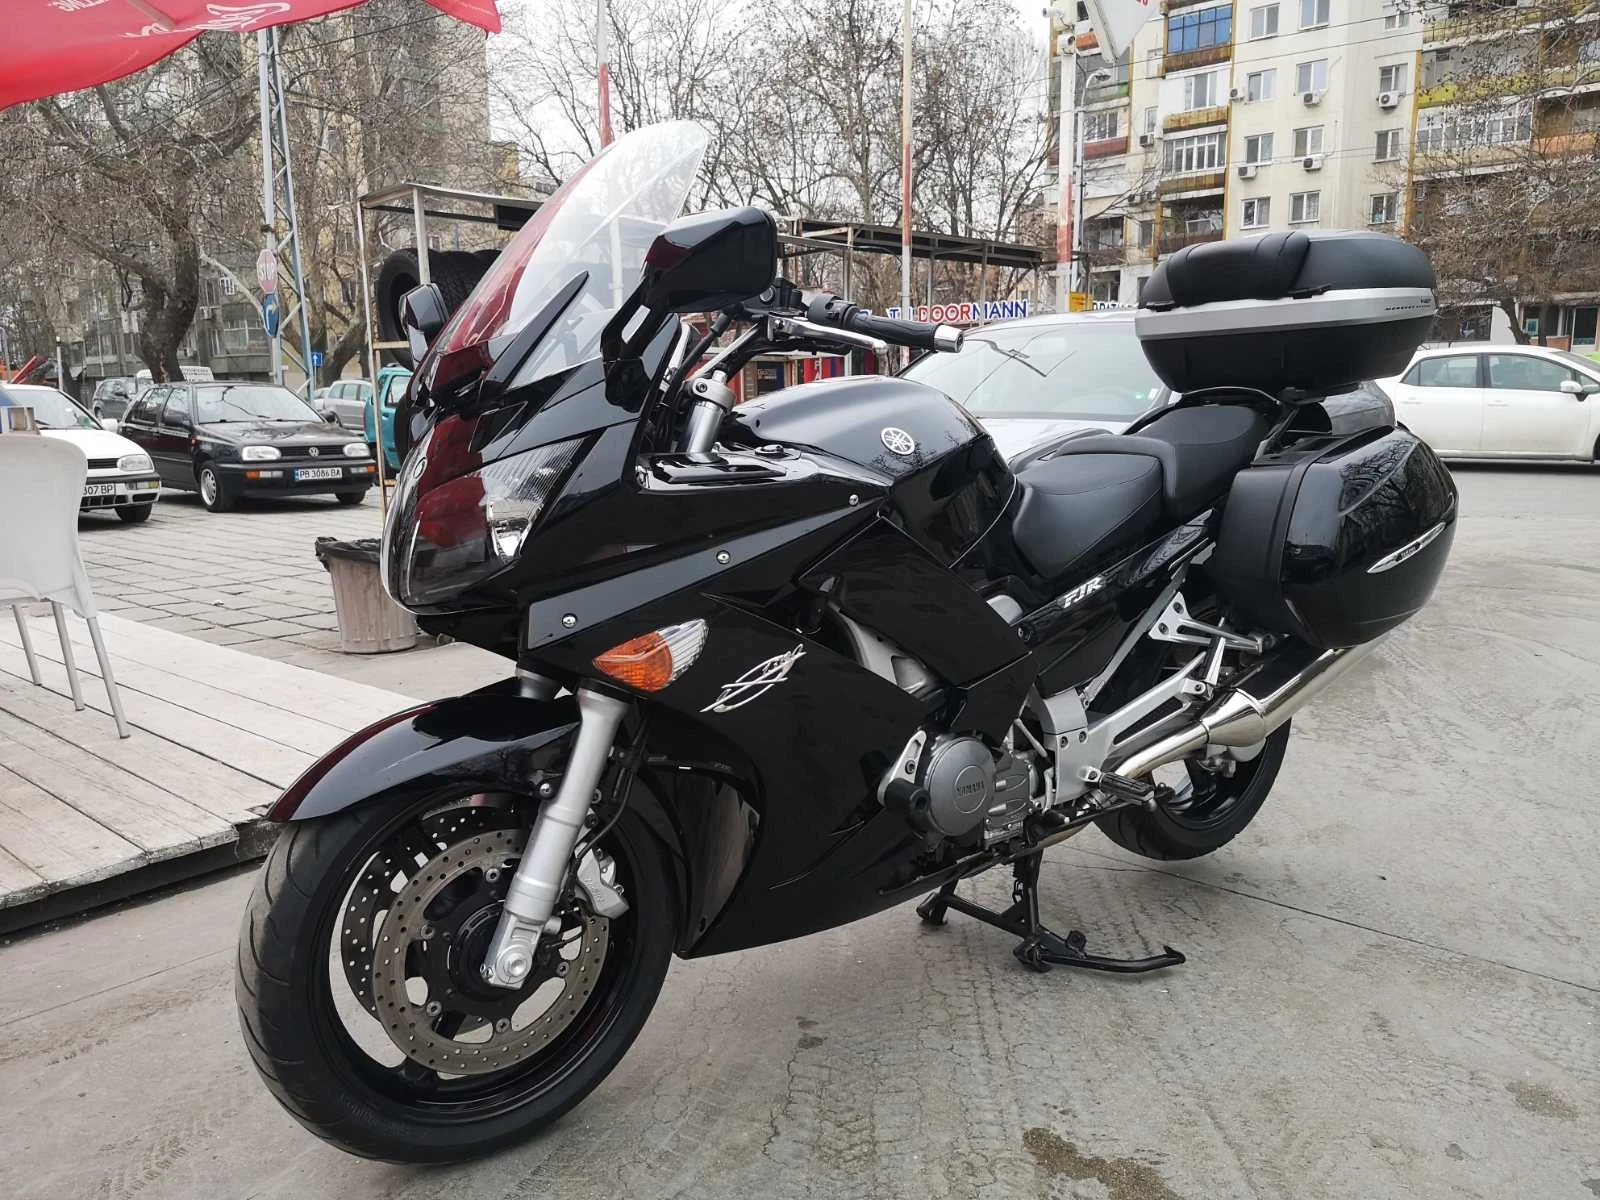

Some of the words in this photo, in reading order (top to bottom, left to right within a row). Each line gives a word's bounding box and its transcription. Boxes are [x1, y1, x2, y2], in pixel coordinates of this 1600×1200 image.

[918, 301, 1027, 322] DOORMANN
[101, 485, 113, 495] BP
[1060, 577, 1103, 609] FJR
